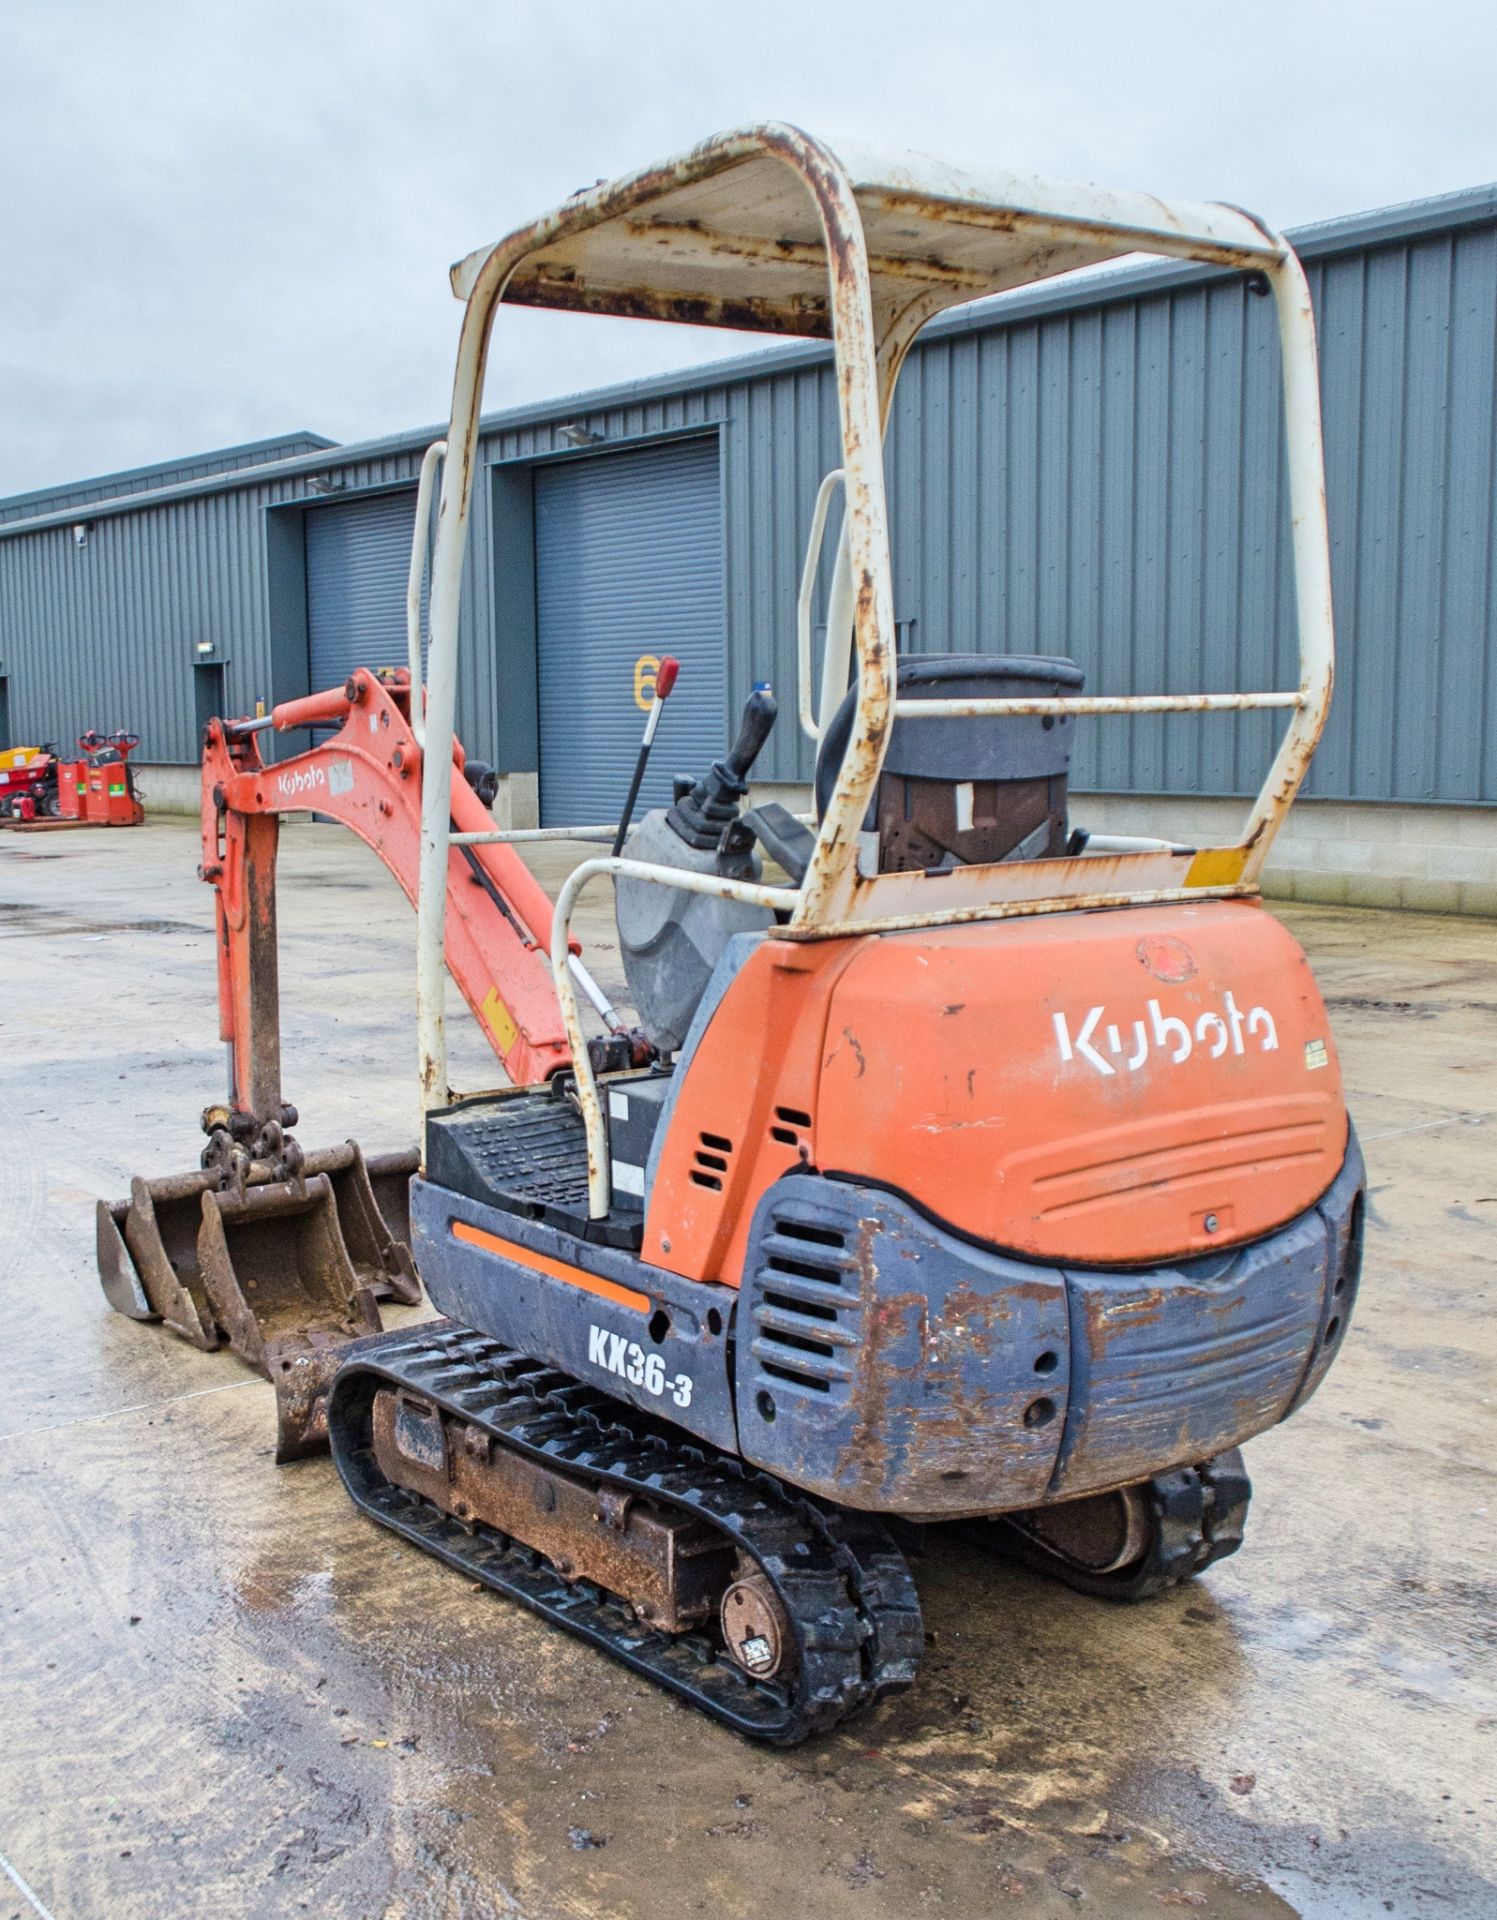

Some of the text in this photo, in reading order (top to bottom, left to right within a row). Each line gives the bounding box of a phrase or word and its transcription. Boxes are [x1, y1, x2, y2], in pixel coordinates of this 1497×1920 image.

[634, 654, 661, 711] 6
[277, 764, 325, 795] Kubota
[1053, 990, 1279, 1075] Kubota
[588, 1324, 693, 1408] KX36-3
